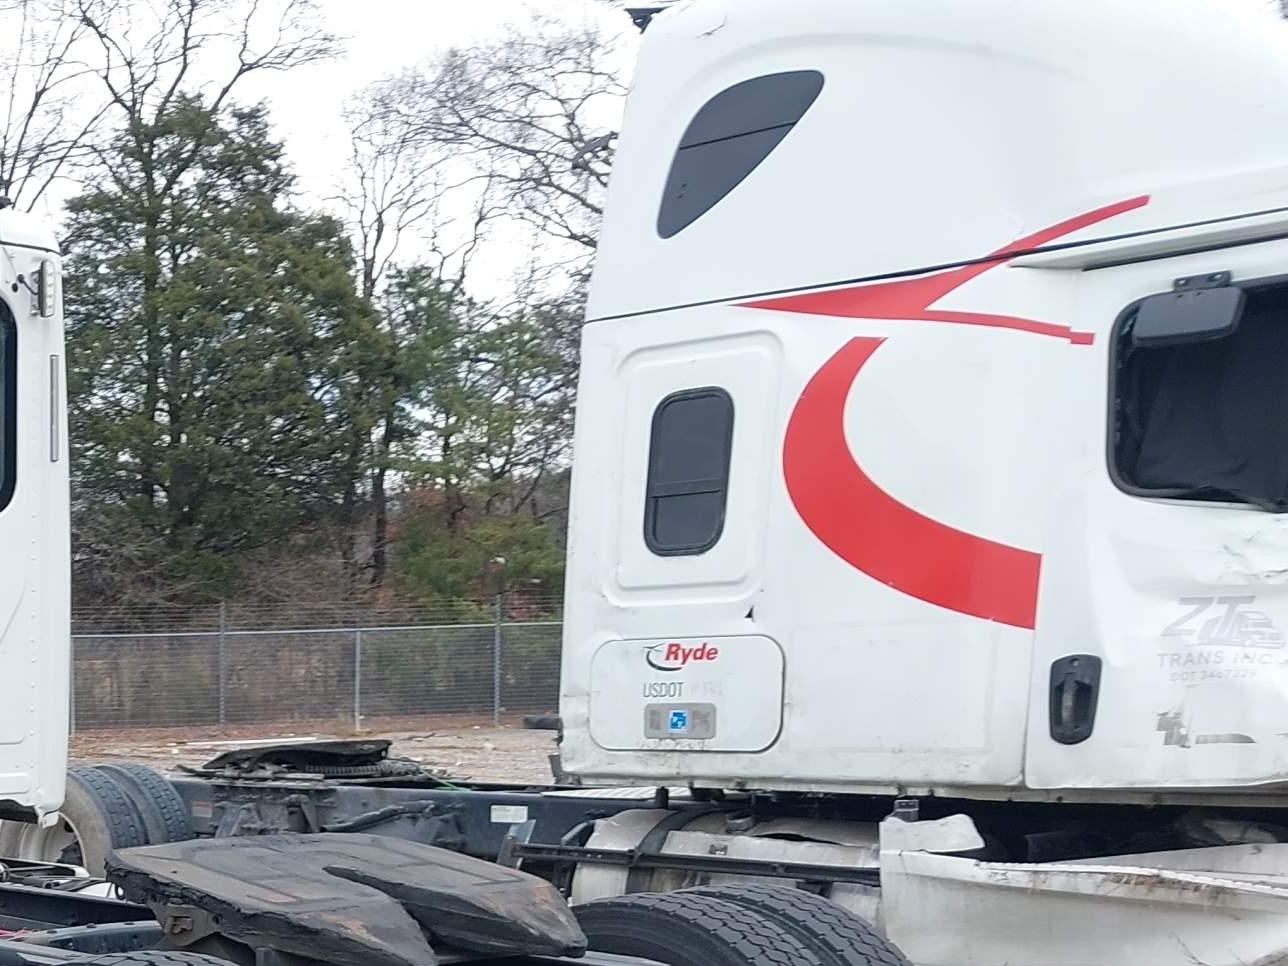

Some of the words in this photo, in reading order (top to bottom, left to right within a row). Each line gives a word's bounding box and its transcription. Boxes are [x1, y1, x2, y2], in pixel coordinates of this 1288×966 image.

[664, 642, 719, 665] Ryde
[1156, 651, 1224, 667] TRANS
[643, 682, 684, 697] USDOT
